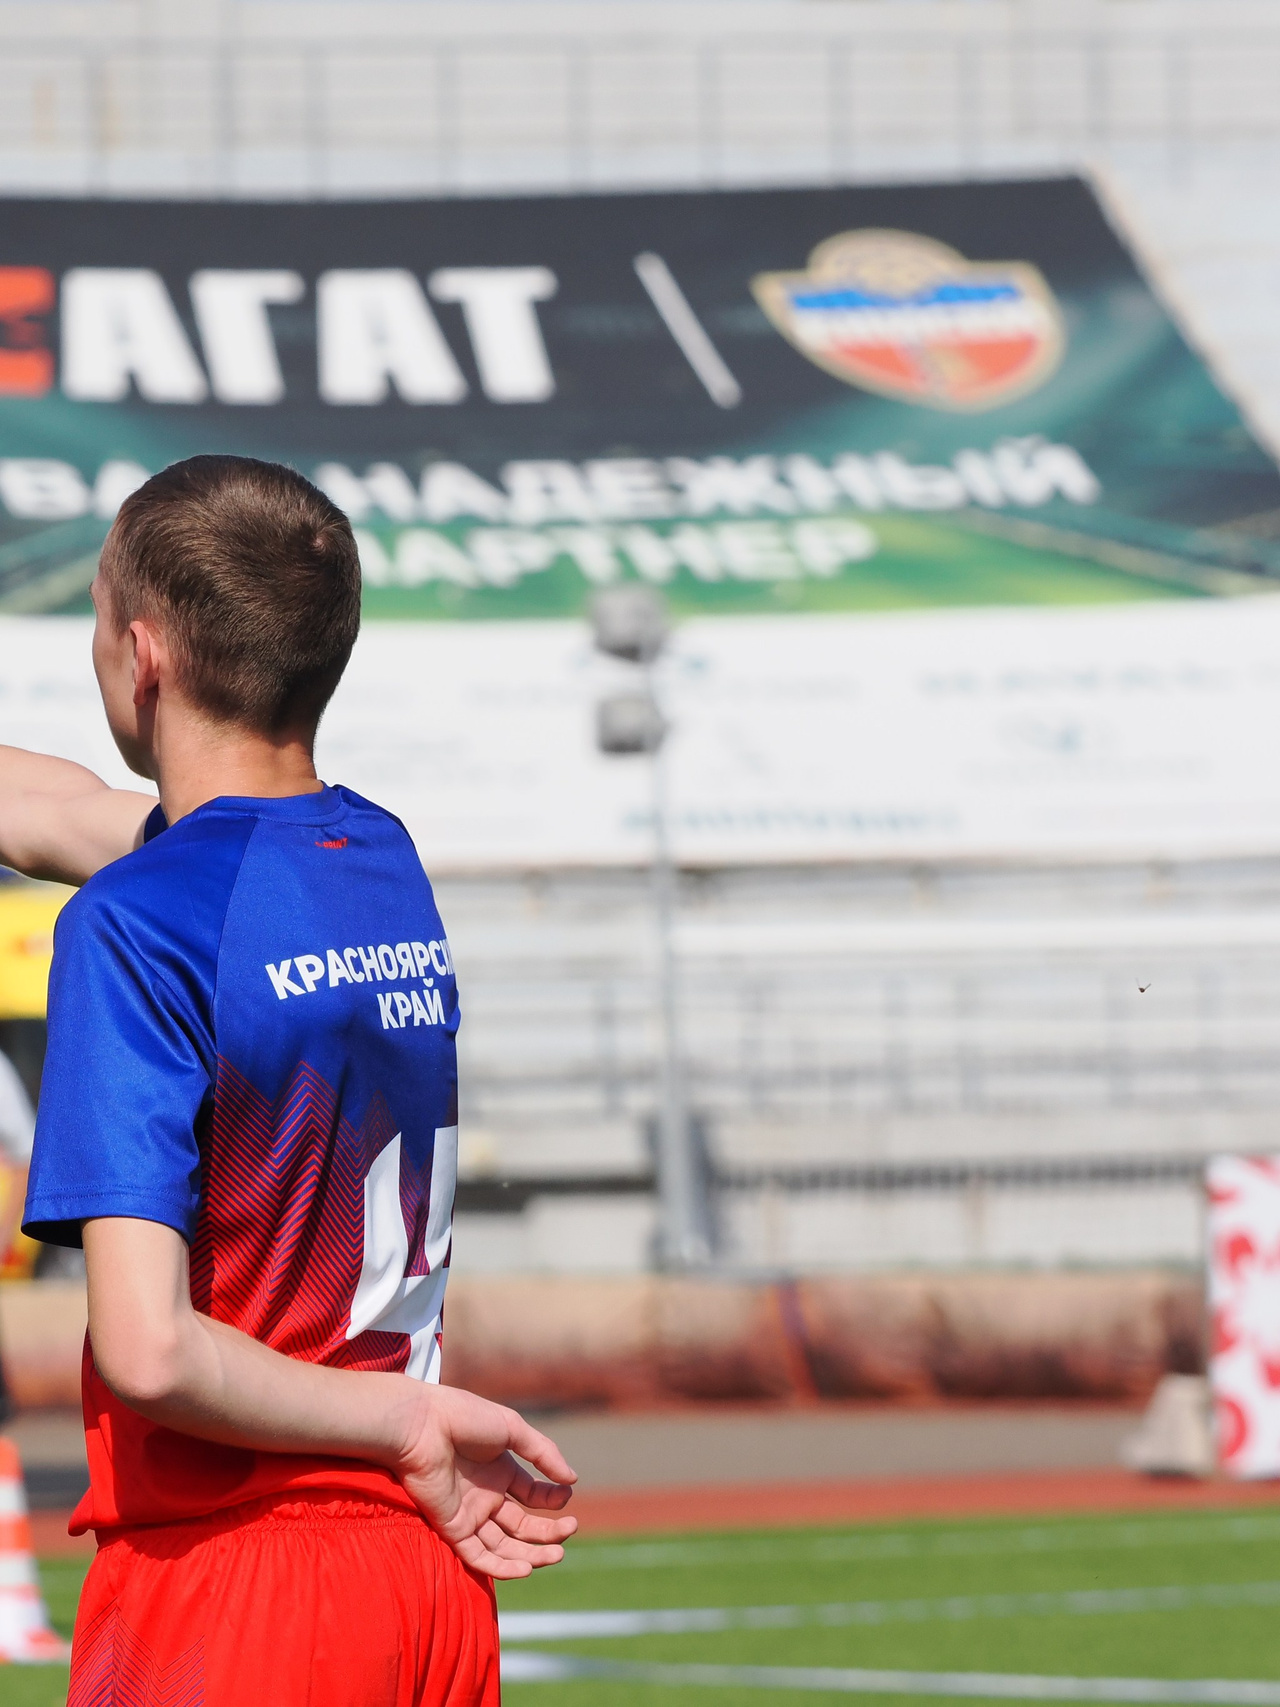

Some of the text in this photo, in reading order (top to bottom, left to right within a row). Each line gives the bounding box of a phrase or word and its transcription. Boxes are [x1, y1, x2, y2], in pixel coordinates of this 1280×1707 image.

[60, 266, 558, 405] АГАТ
[314, 437, 1102, 525] НАДЕЖНЫЙ
[377, 978, 446, 1029] КРАЙ
